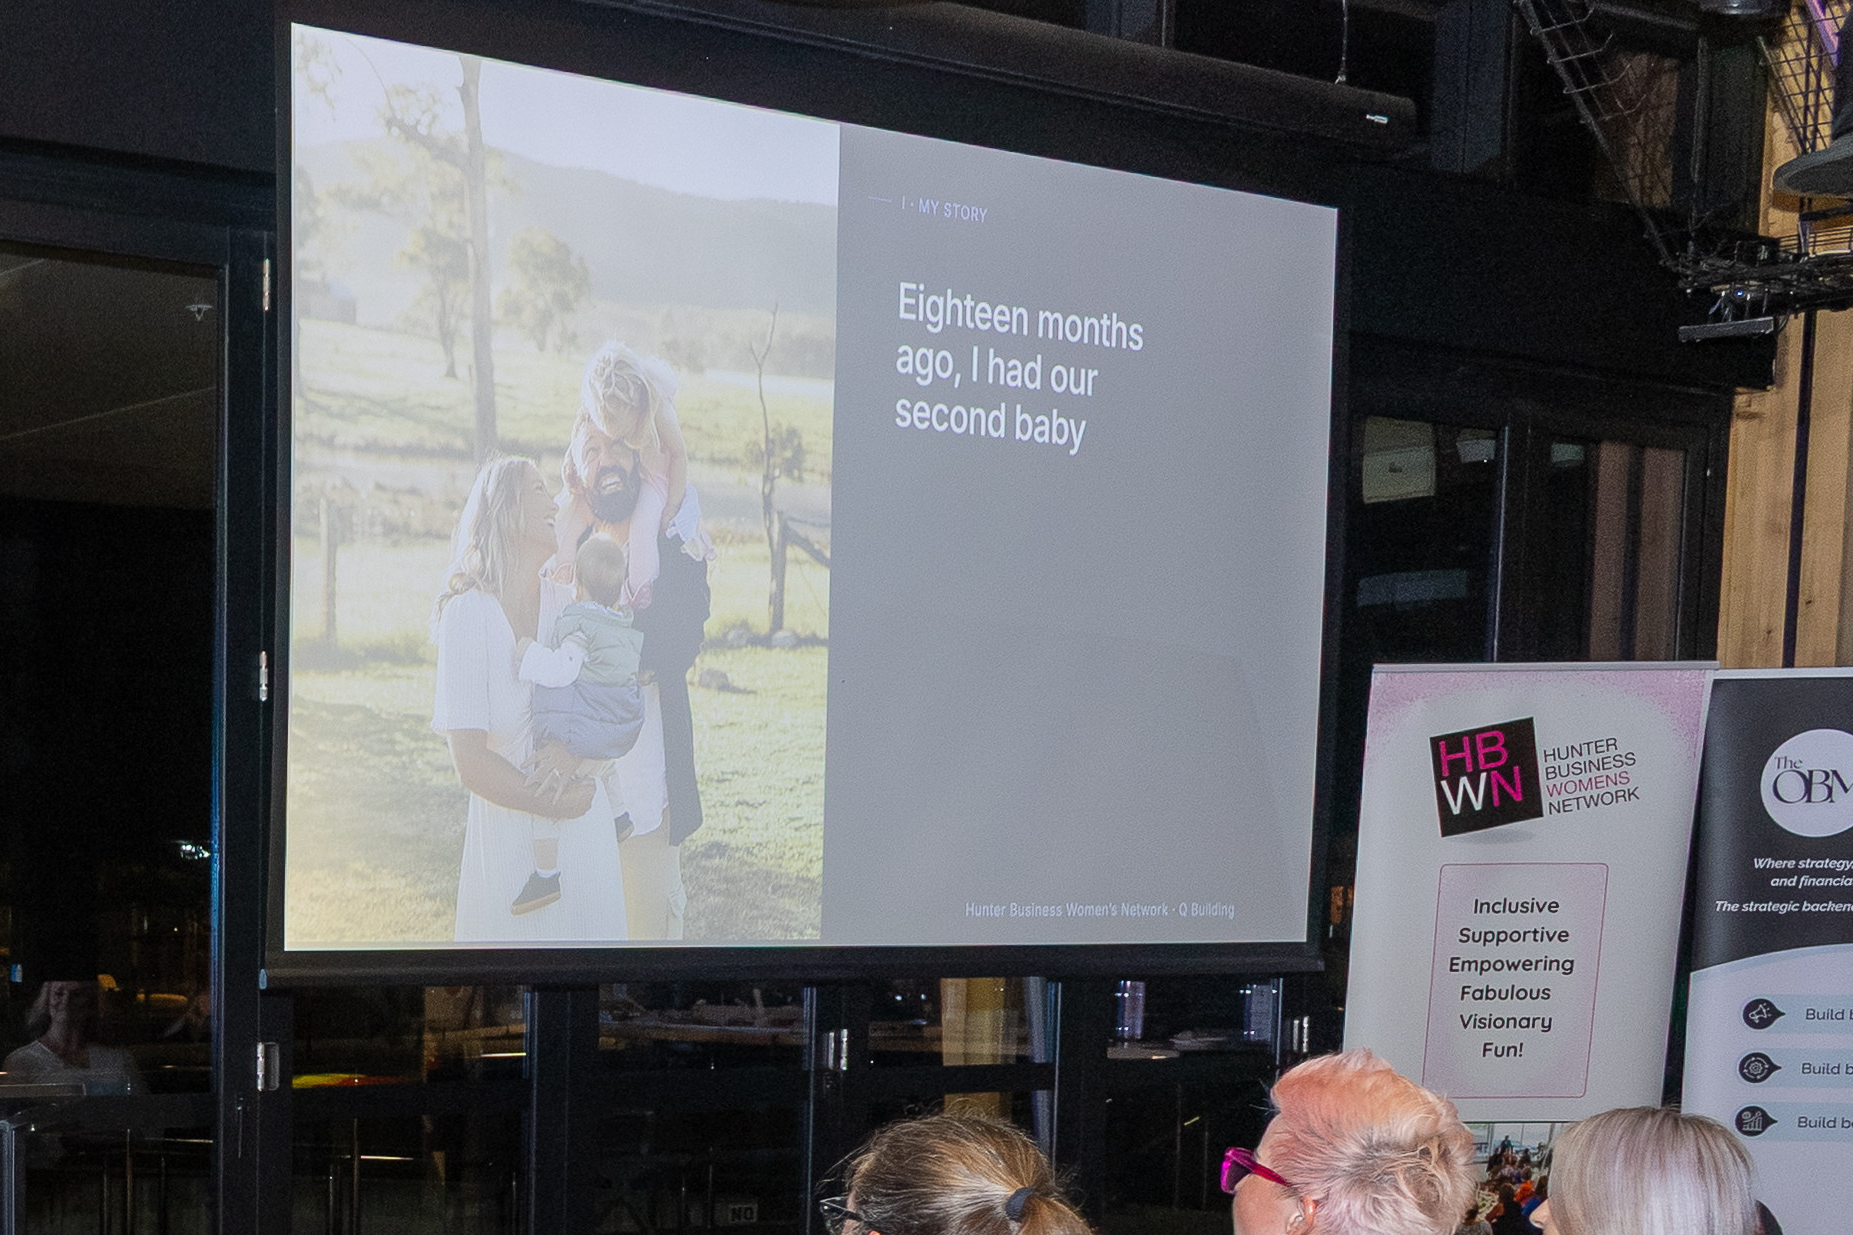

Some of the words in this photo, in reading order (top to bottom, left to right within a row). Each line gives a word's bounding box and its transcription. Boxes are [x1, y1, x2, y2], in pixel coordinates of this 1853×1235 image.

[918, 198, 940, 216] MY
[944, 202, 988, 223] STORY
[898, 281, 1029, 336] Eighteen
[1038, 308, 1144, 352] months
[895, 344, 962, 389] ago,
[972, 347, 978, 382] I
[988, 348, 1042, 390] had
[1050, 363, 1098, 397] our
[895, 399, 1007, 439] second
[1015, 403, 1087, 457] baby
[1439, 730, 1508, 776] HB
[1543, 737, 1618, 762] HUNTER
[1544, 753, 1637, 780] BUSINESS
[1775, 756, 1803, 769] The
[1441, 766, 1522, 815] WN
[1546, 771, 1631, 797] WOMENS
[1548, 787, 1640, 815] NETWORK
[1754, 858, 1795, 869] Where
[1771, 876, 1798, 886] and
[1799, 876, 1853, 889] financia
[965, 902, 1006, 917] Hunter
[1009, 902, 1062, 917] Business
[1121, 902, 1168, 916] Network
[1191, 903, 1235, 920] Building
[1473, 898, 1560, 915] Inclusive
[1715, 901, 1739, 912] The
[1742, 901, 1799, 914] strategic
[1802, 900, 1853, 912] backen
[1458, 927, 1570, 947] Supportive
[1449, 956, 1575, 975] Empowering
[1460, 985, 1552, 1001] Fabulous
[1460, 1013, 1553, 1032] Visionary
[1805, 1008, 1845, 1020] Build
[1482, 1041, 1524, 1058] Fun!
[1802, 1063, 1840, 1074] Build
[1798, 1116, 1836, 1128] Build
